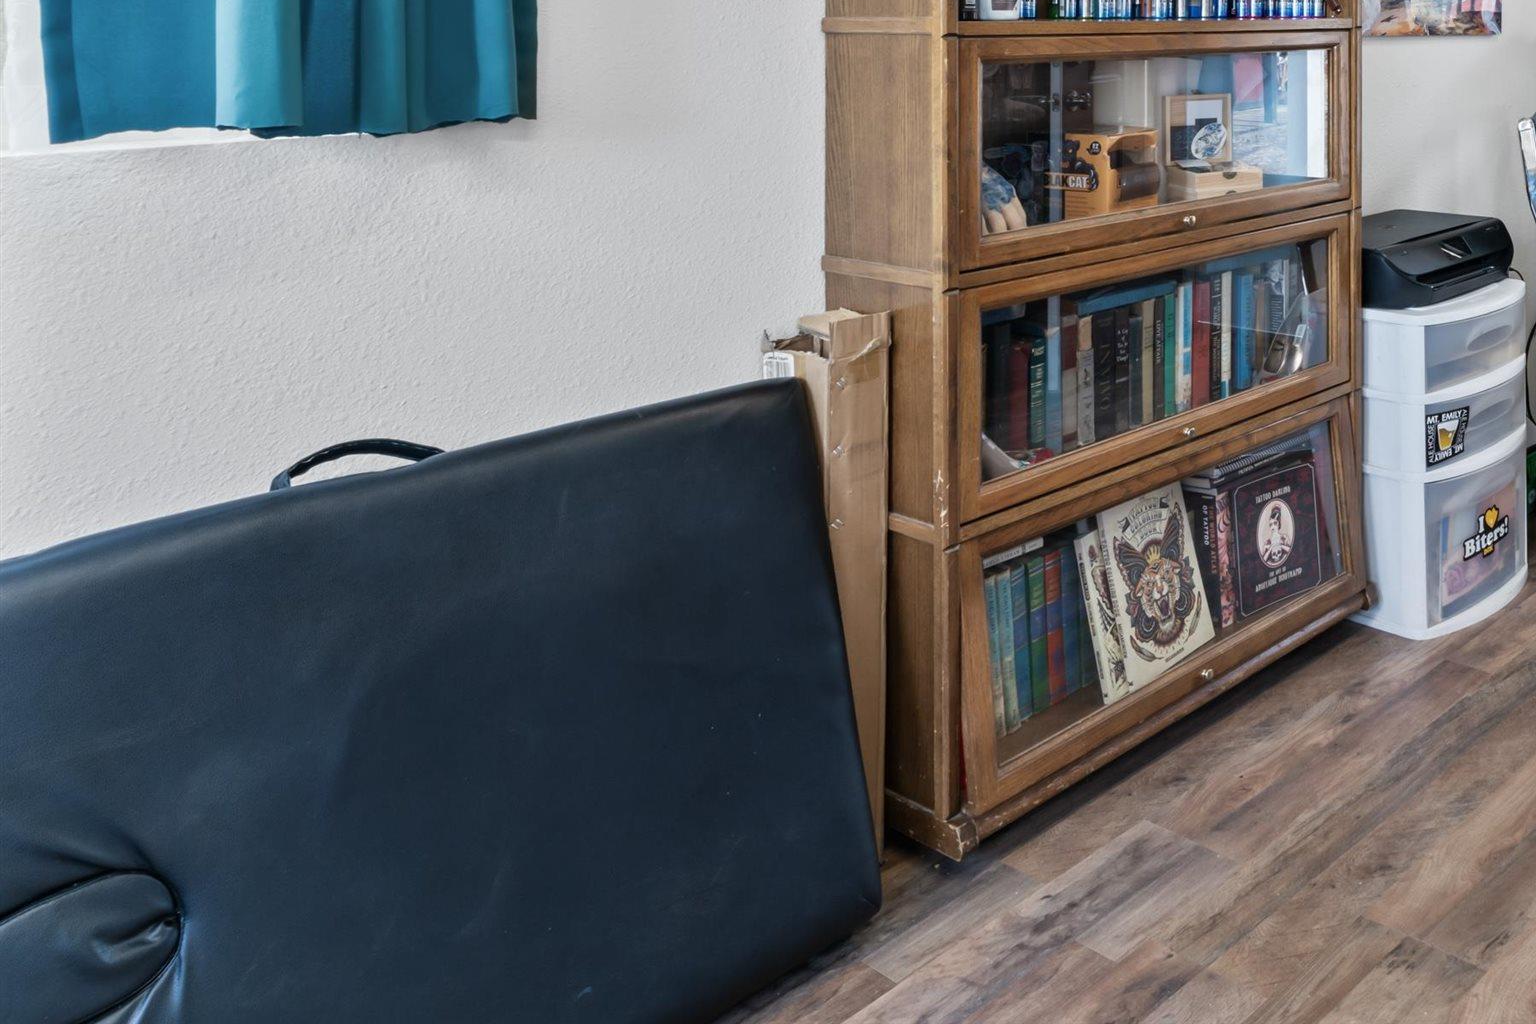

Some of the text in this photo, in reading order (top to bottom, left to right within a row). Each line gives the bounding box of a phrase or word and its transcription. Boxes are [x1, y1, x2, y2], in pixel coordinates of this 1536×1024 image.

[1441, 410, 1462, 422] EMILY
[1202, 516, 1210, 546] TATTOO
[1478, 515, 1485, 533] I
[1464, 516, 1508, 559] Biters!
